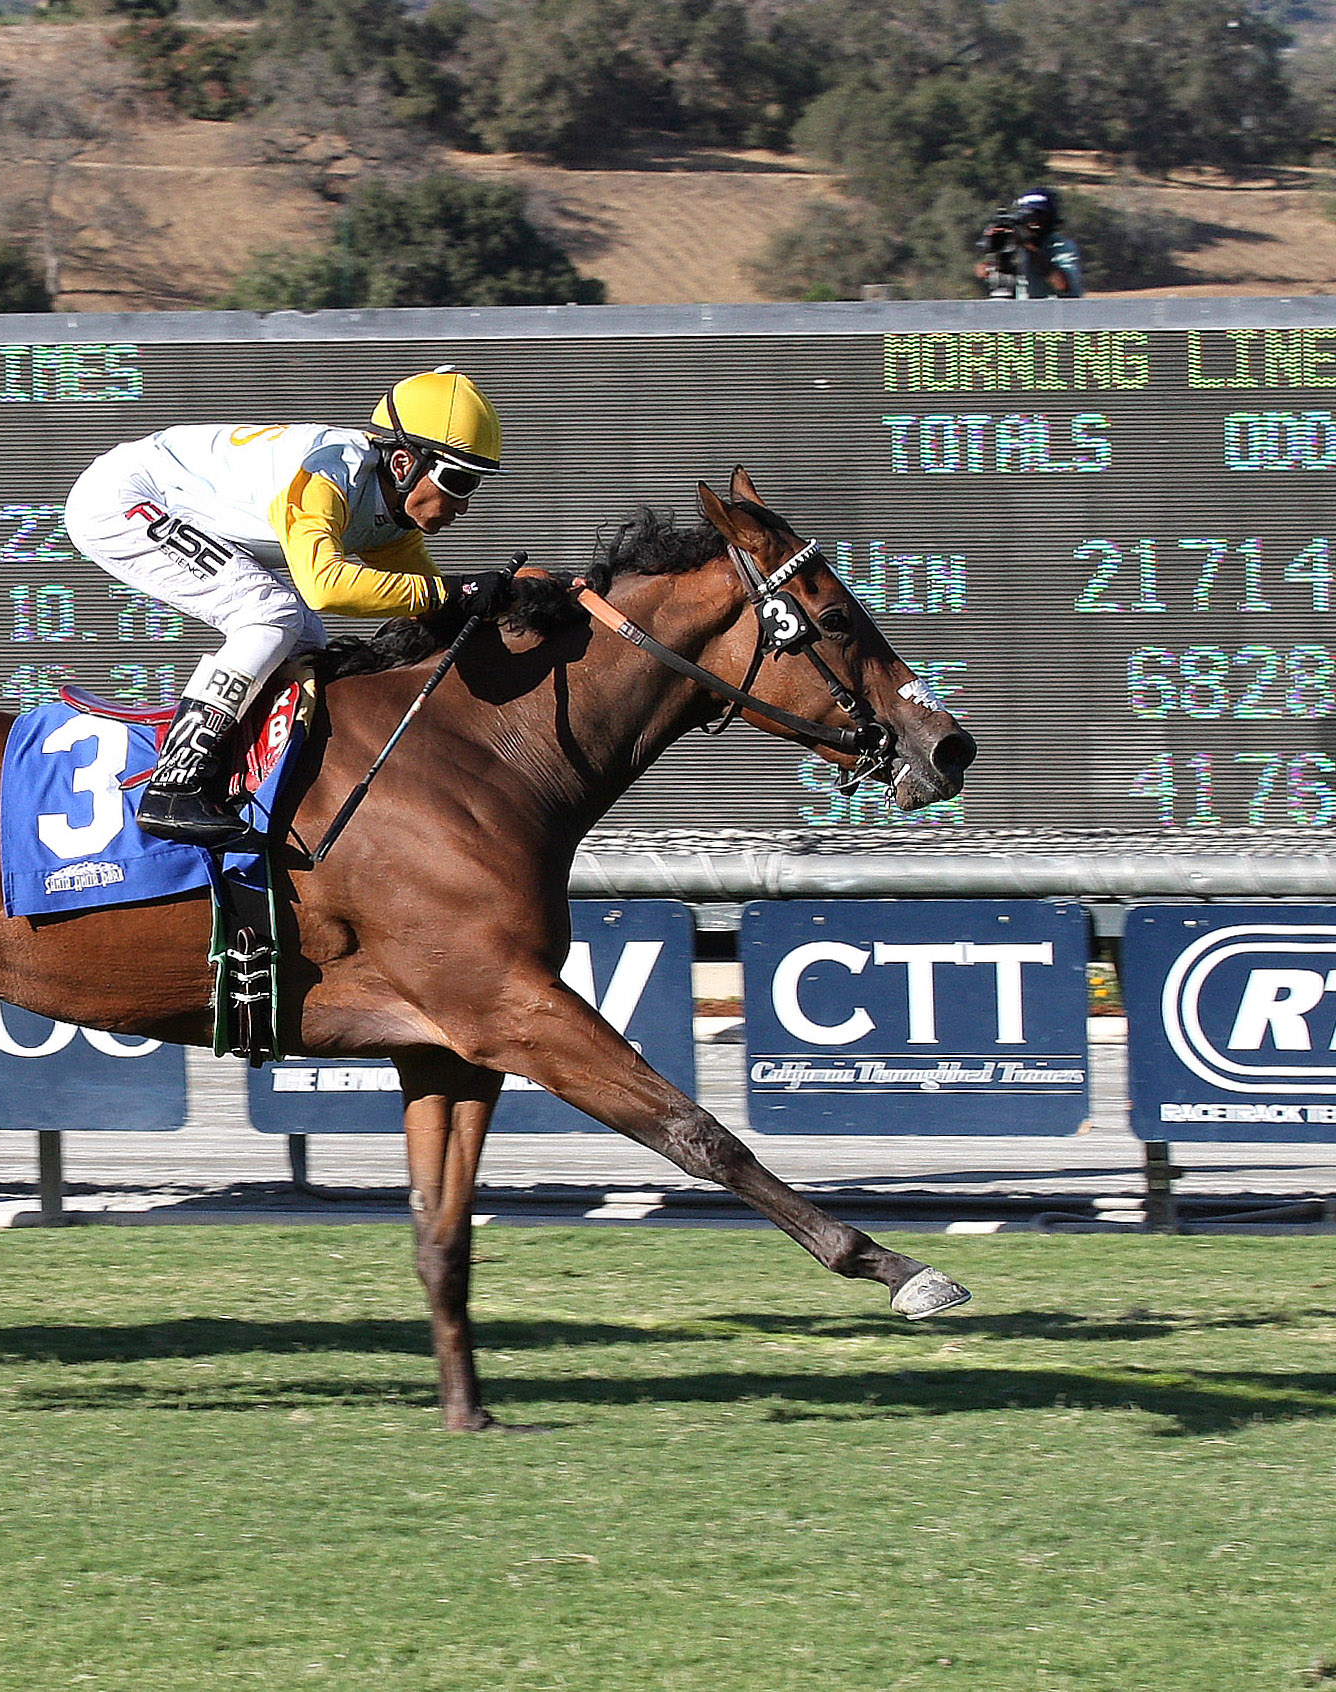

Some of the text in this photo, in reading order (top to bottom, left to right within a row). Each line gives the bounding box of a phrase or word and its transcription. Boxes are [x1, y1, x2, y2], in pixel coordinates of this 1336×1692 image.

[883, 328, 1336, 391] MORNING LINE
[882, 413, 1112, 473] TOTALS
[125, 501, 233, 576] FUSE
[159, 544, 210, 582] SCIENCE
[1073, 538, 1335, 613] 21714
[763, 598, 798, 639] 3
[206, 668, 252, 705] RB
[1127, 645, 1336, 719] 6828
[37, 714, 129, 859] 3
[1128, 752, 1336, 827] 4176
[45, 877, 72, 894] SANTA
[772, 941, 1054, 1046] CTT
[1160, 1103, 1306, 1123] RACETRACK
